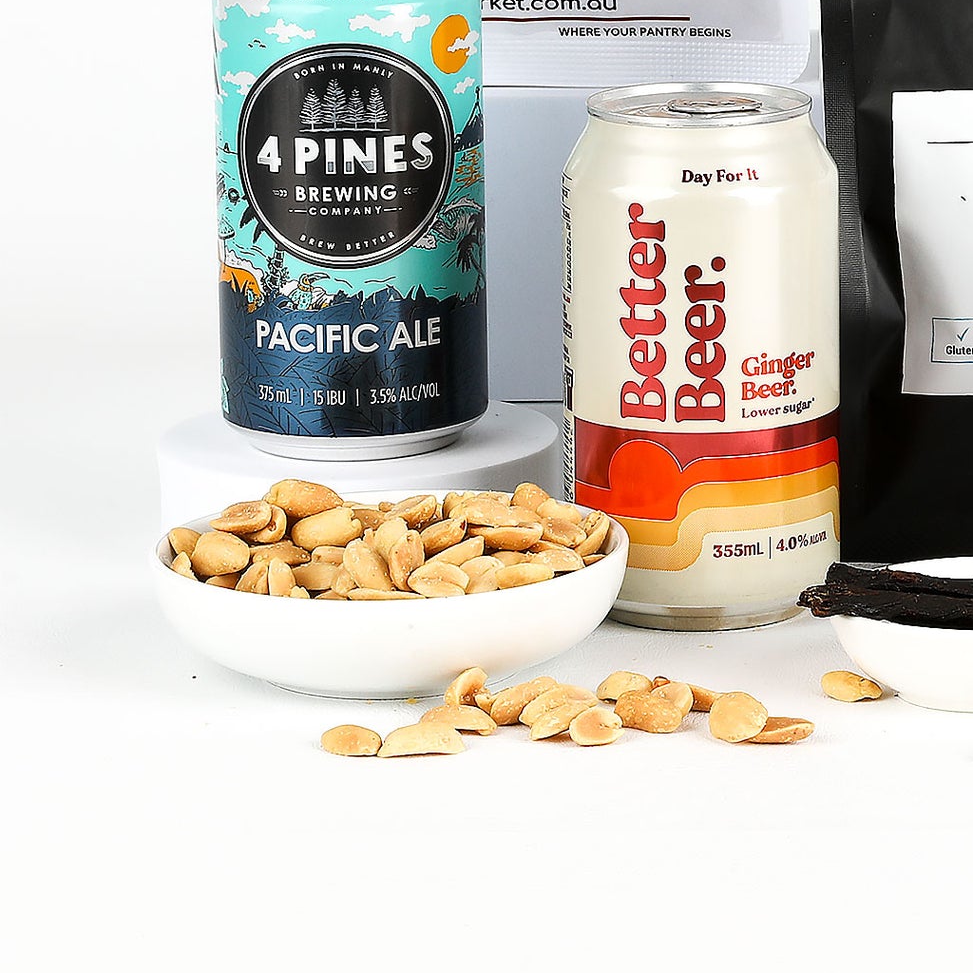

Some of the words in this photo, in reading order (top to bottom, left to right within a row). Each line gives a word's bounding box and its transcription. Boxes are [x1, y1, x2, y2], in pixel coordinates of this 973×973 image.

[558, 27, 602, 37] WHERE
[603, 27, 638, 37] YOUR
[640, 27, 686, 37] PANTRY
[689, 27, 732, 38] BEGINS
[293, 64, 325, 80] BORN
[331, 62, 345, 70] IN
[352, 62, 395, 80] MANLY
[257, 135, 282, 173] 4
[294, 132, 434, 175] PINES
[681, 170, 713, 187] Day
[716, 169, 743, 182] For
[747, 168, 759, 180] It
[294, 185, 397, 203] BREWING
[309, 206, 383, 216] COMPANY
[300, 234, 336, 250] BREW
[346, 231, 396, 251] BETTER
[619, 202, 667, 422] Better
[256, 319, 380, 354] PACIFIC
[388, 316, 441, 350] ALE
[674, 255, 727, 423] Beer.
[741, 351, 815, 379] Ginger
[326, 389, 346, 405] IBU
[370, 387, 397, 405] 3.5%
[399, 382, 441, 402] ALC/VOL
[741, 379, 797, 400] Beer.
[742, 407, 781, 418] Lower
[713, 542, 764, 558] 355mL
[776, 533, 808, 552] 4.0%
